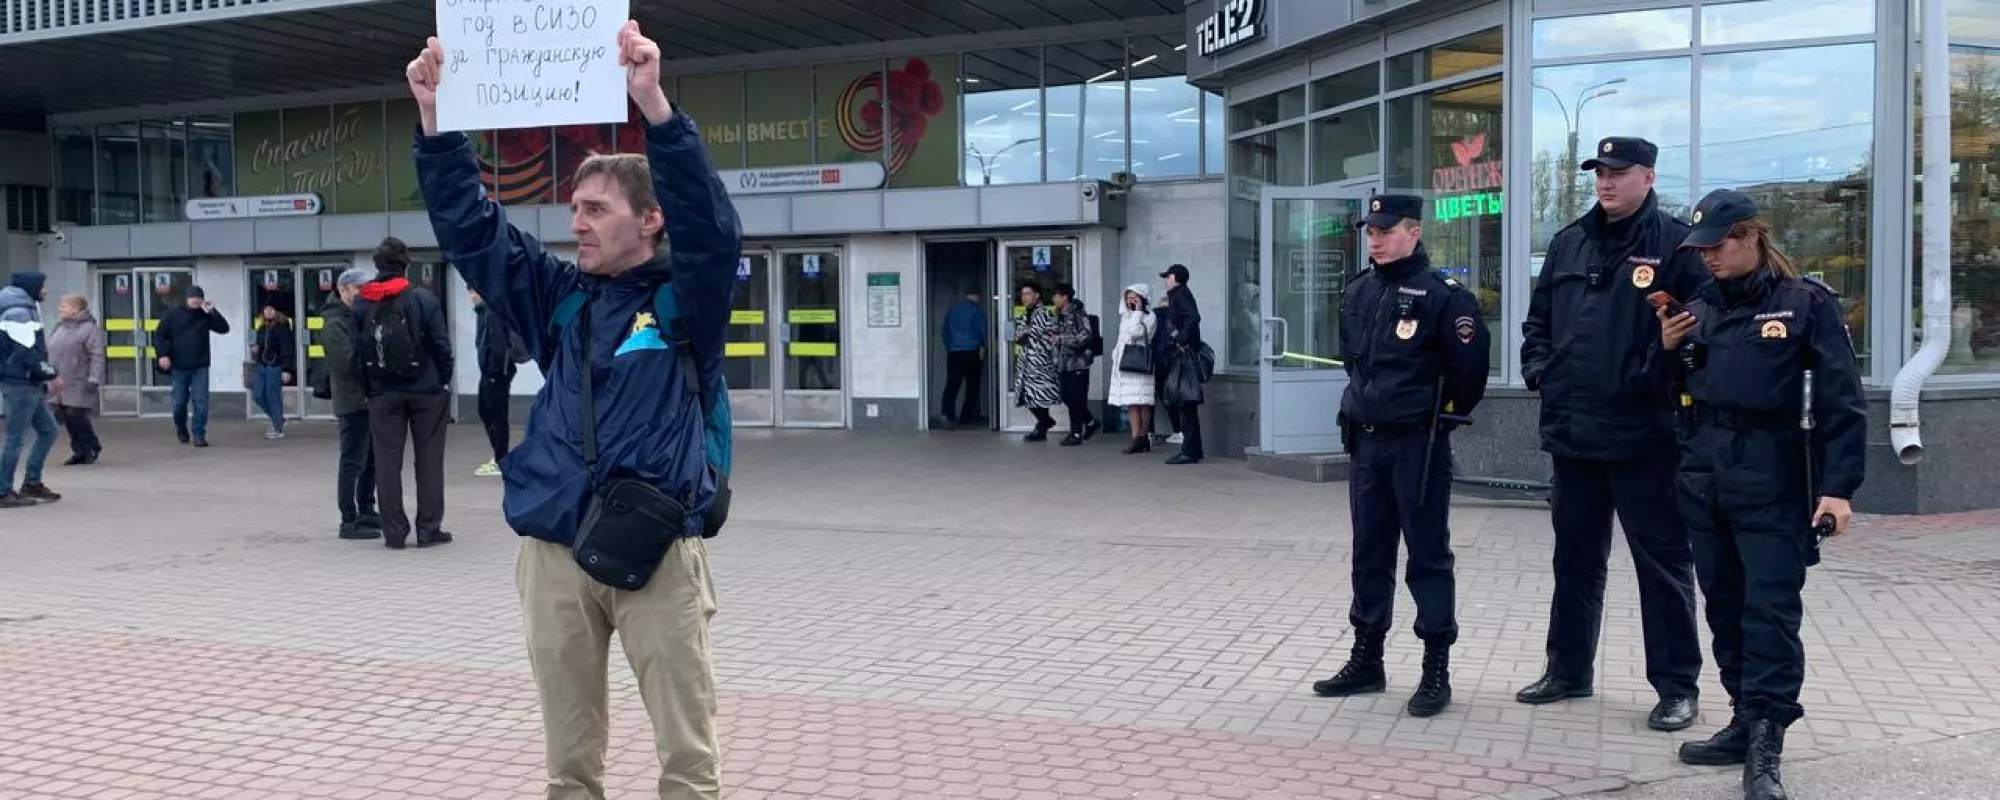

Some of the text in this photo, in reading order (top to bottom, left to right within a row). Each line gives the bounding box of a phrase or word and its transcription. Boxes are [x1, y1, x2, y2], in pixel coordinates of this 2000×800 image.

[463, 16, 495, 47] год
[534, 4, 598, 31] СИЗО
[1195, 0, 1255, 57] TELE2
[450, 49, 469, 74] за
[1435, 191, 1503, 223] ЦВЕТЫ
